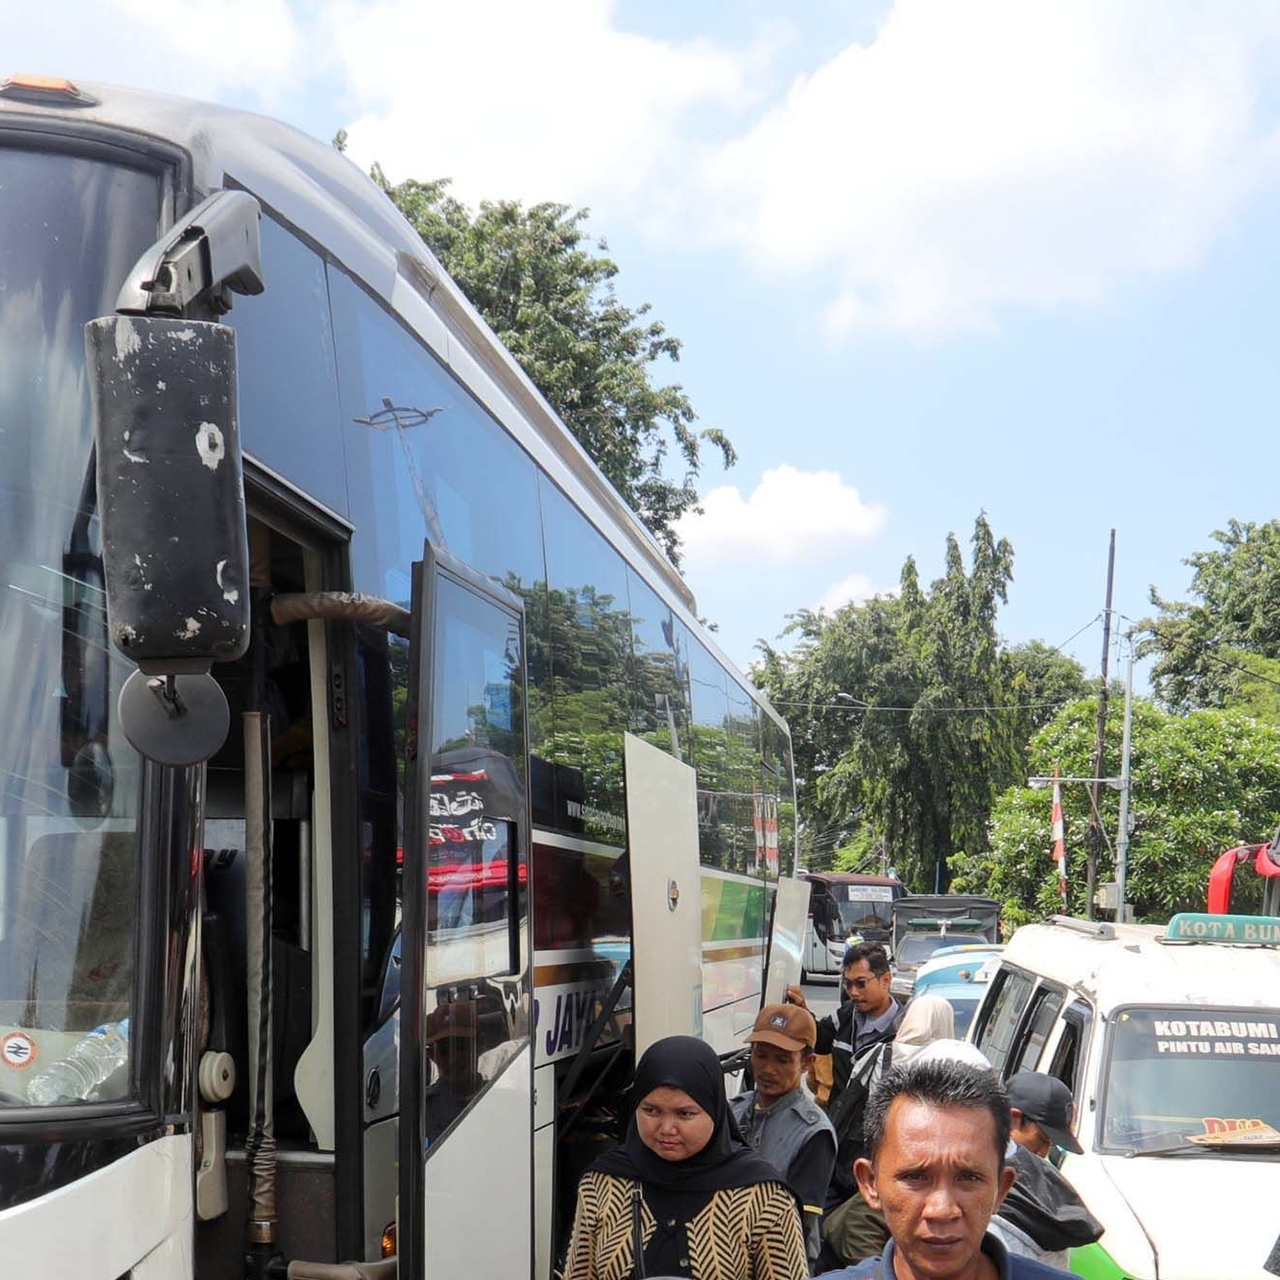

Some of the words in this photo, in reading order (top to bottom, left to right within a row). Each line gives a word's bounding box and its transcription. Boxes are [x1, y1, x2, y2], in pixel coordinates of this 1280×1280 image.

[1178, 920, 1236, 938] KOTA
[1154, 1020, 1278, 1038] KOTABUMI
[1157, 1041, 1211, 1053] PINTU
[1214, 1042, 1245, 1054] AIR
[1202, 1117, 1264, 1135] DU
